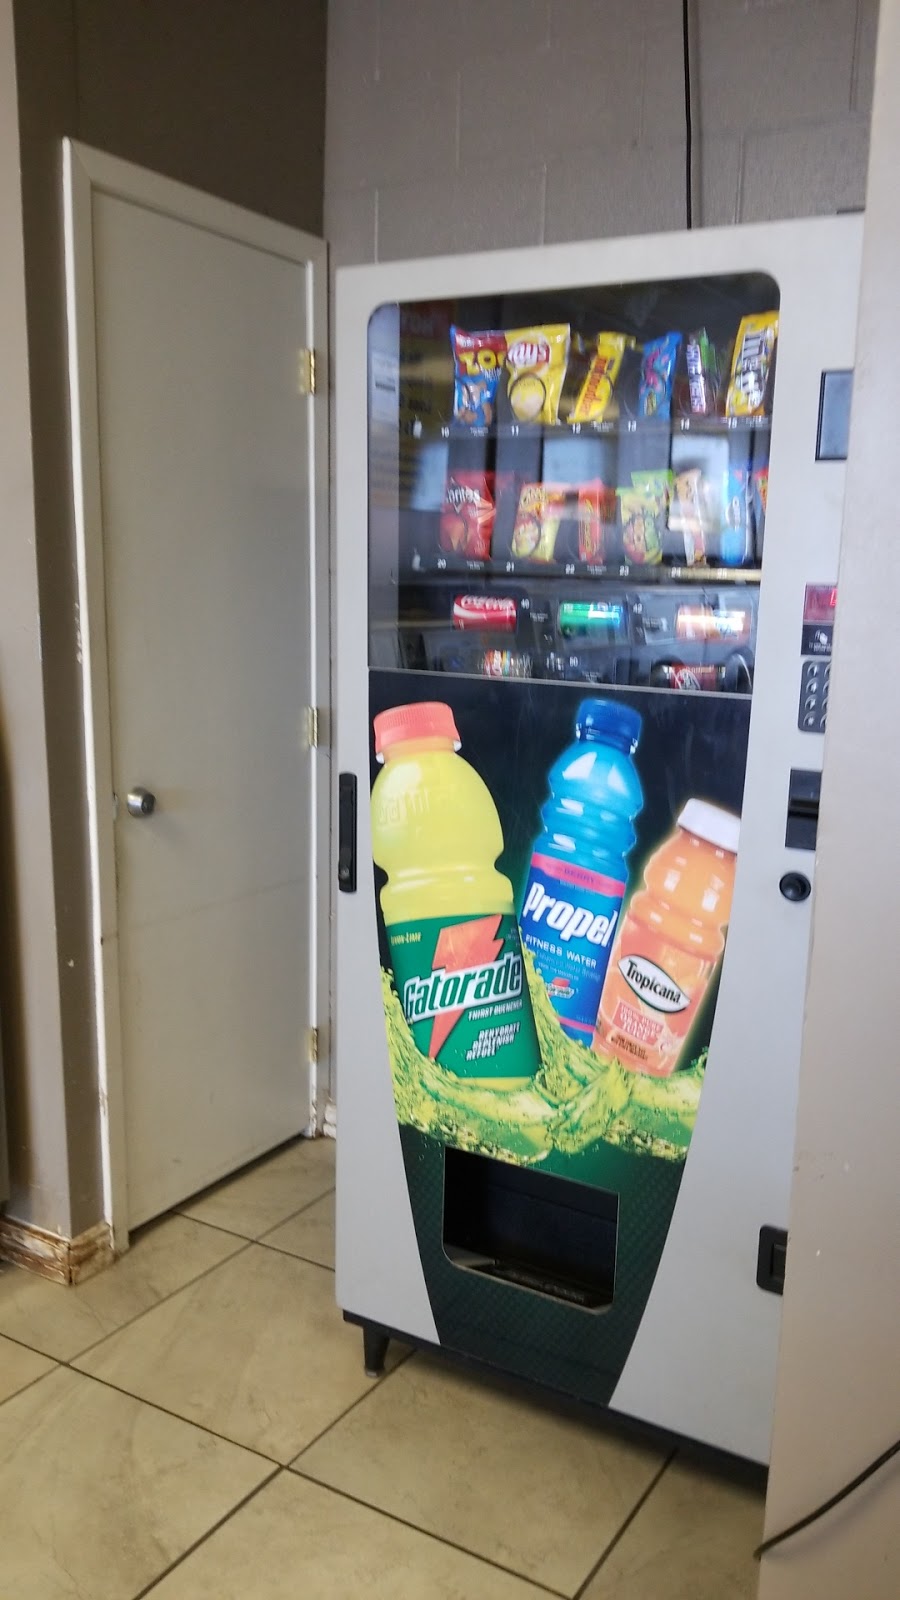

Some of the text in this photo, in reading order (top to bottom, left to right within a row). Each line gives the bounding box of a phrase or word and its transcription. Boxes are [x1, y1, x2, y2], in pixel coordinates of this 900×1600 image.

[447, 488, 481, 504] oritos
[522, 882, 618, 947] Propel
[526, 934, 562, 957] FITNESS
[566, 950, 597, 968] WATER
[404, 952, 522, 1023] Gatorade
[626, 958, 681, 1004] Tropicana
[468, 999, 522, 1021] THIRST QUENCHER
[478, 1022, 520, 1040] REHYDRATE
